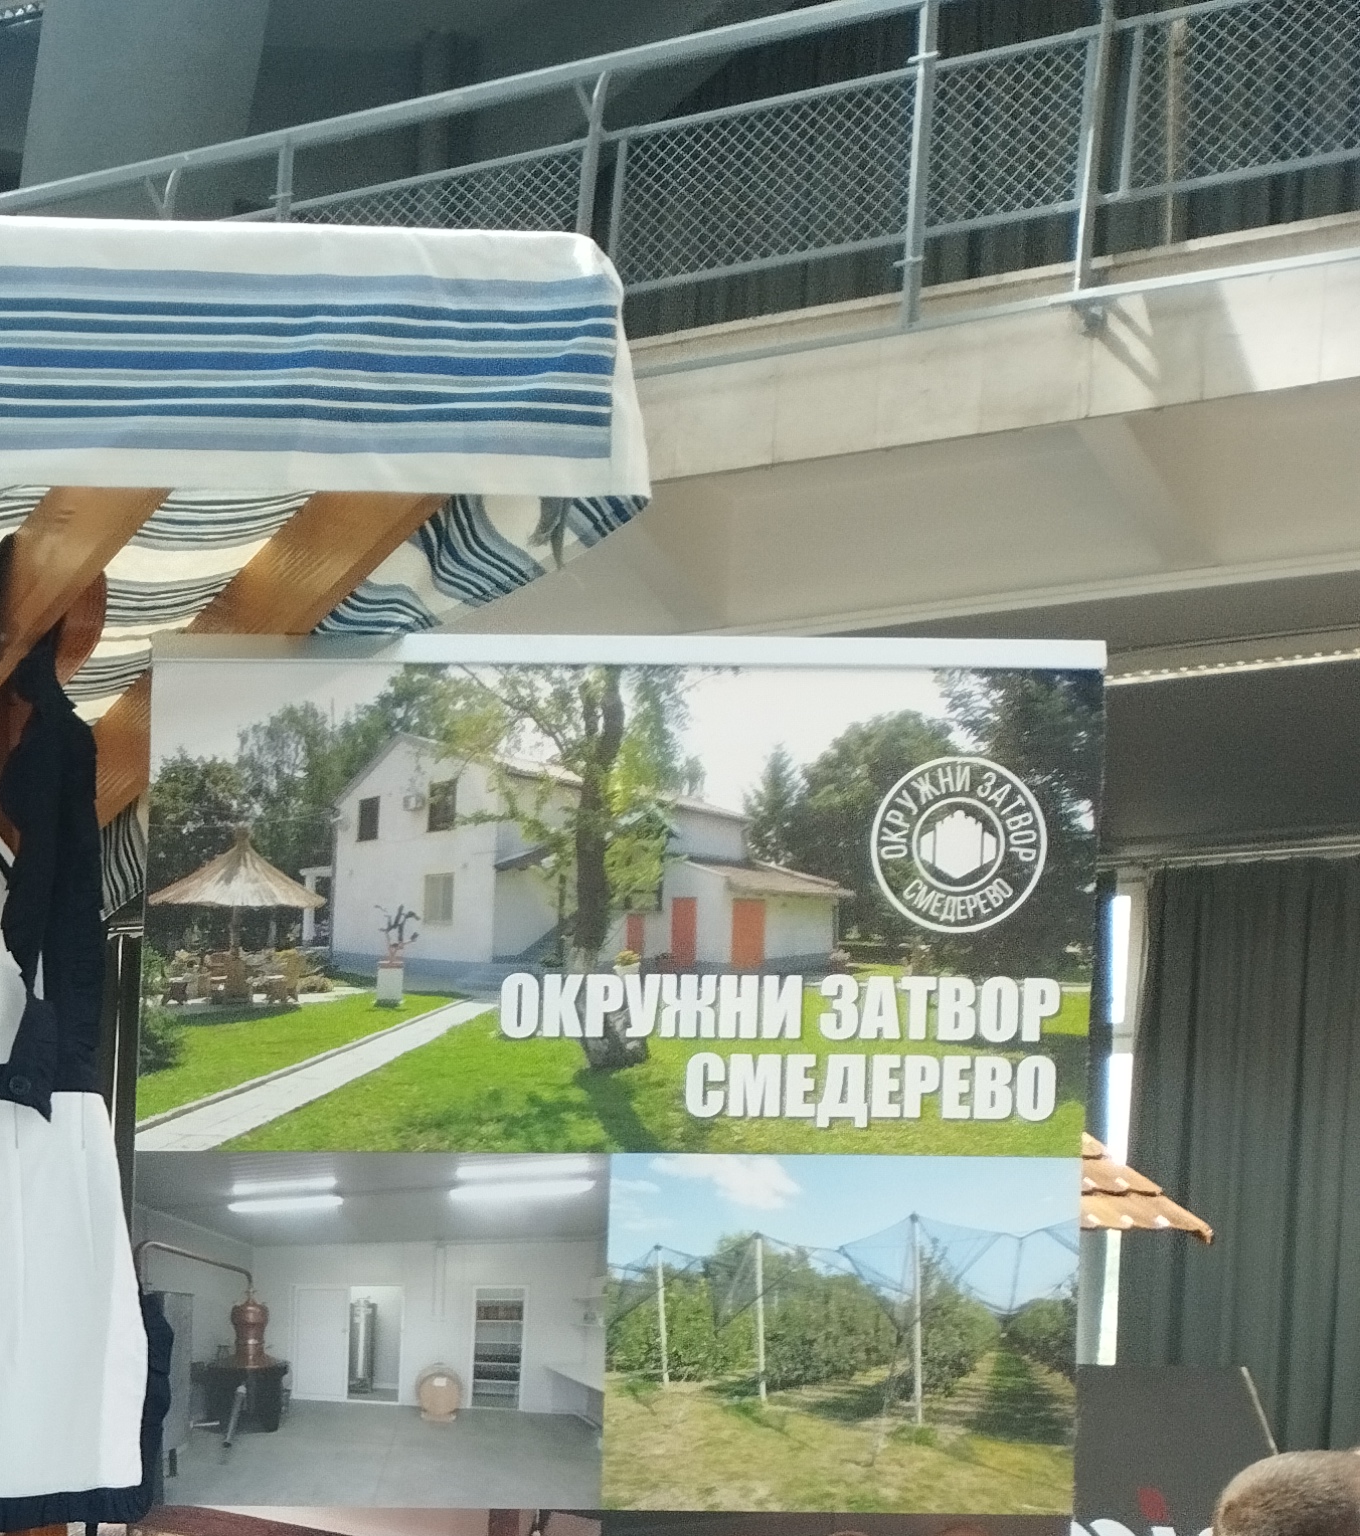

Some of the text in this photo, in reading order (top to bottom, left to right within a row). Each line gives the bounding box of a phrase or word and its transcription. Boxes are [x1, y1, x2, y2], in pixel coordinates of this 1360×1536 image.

[880, 765, 1037, 862] ОКРУЖНИ ЗАТВОР
[903, 878, 1014, 923] СМЕДЕРЕВО
[500, 972, 1061, 1043] ОКРУЖНИ ЗАТВОР
[686, 1052, 1057, 1128] СМЕДЕРЕВО
